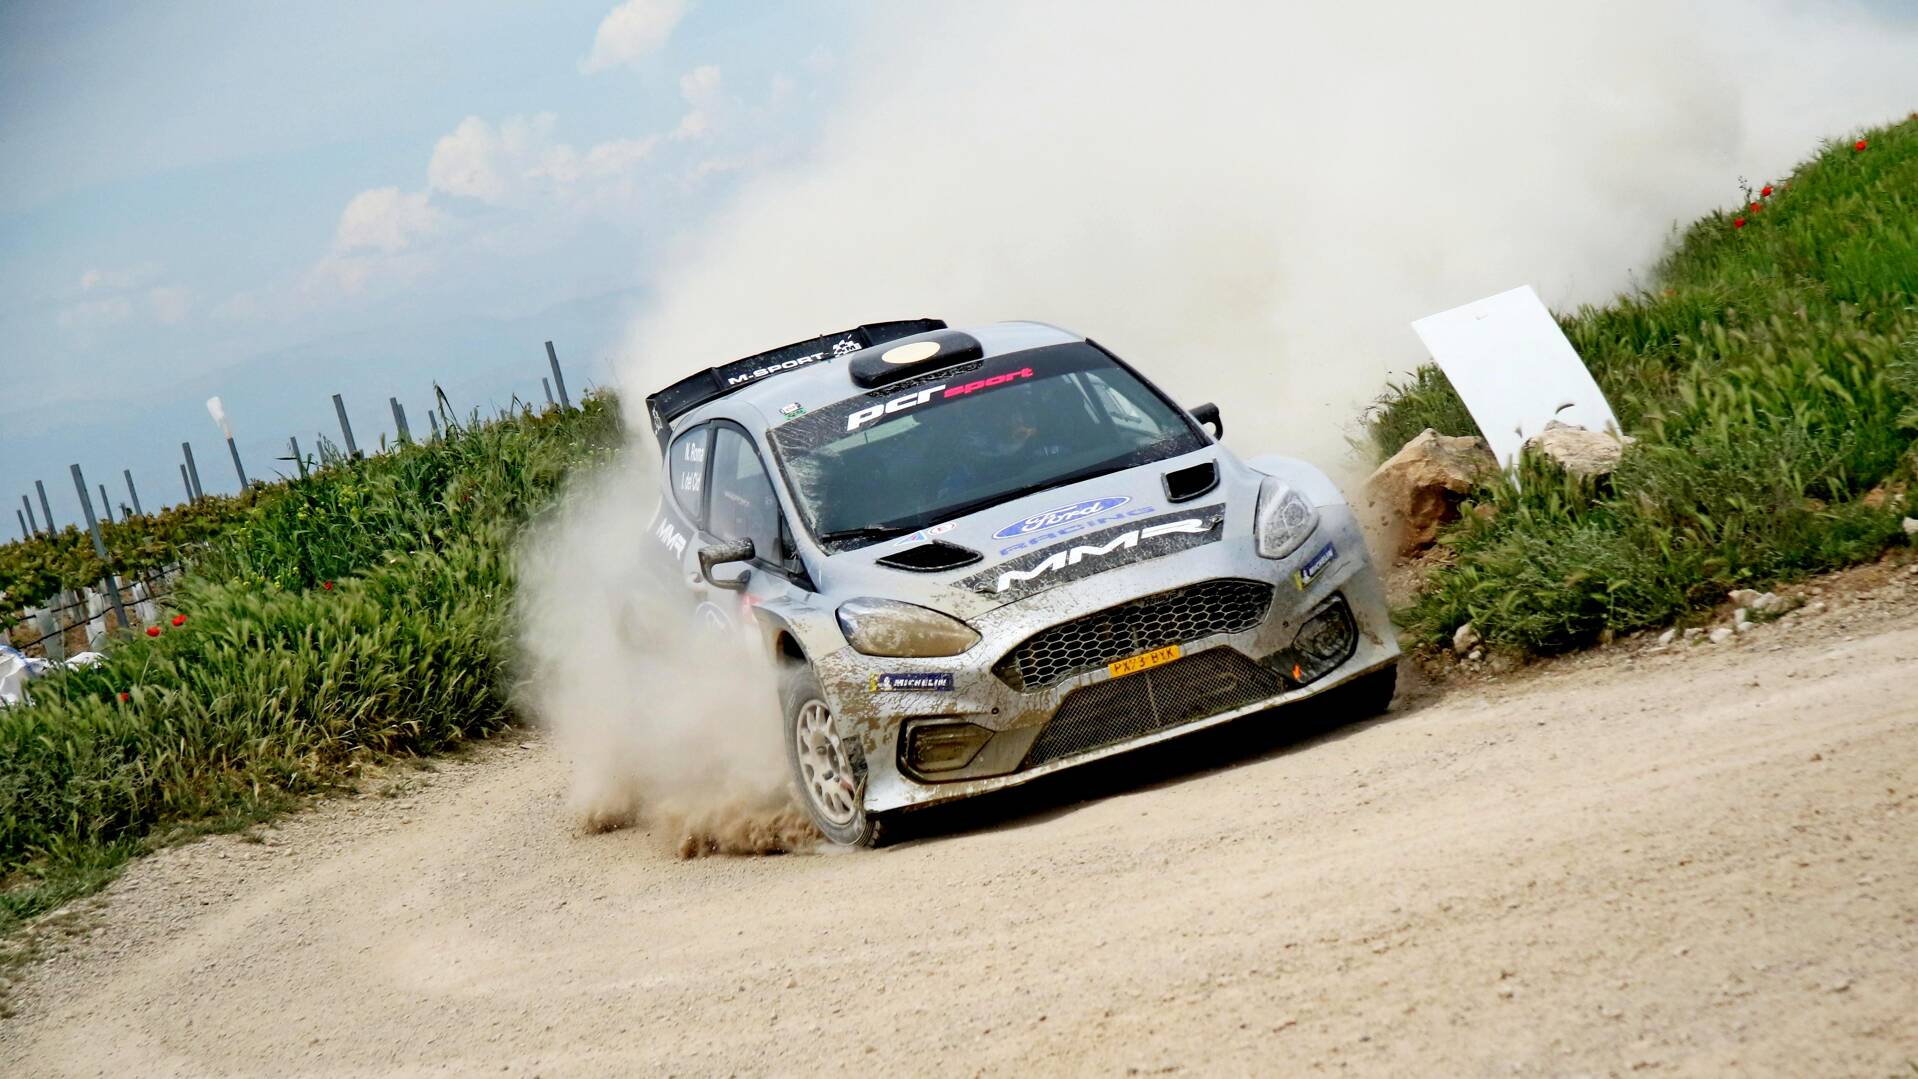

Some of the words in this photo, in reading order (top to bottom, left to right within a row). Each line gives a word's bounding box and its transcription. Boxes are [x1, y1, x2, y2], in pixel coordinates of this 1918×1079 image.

[999, 505, 1156, 556] RACING
[1021, 501, 1102, 532] Ford
[656, 518, 687, 561] MMR
[997, 518, 1211, 593] MMR
[894, 678, 947, 687] MICHELIN
